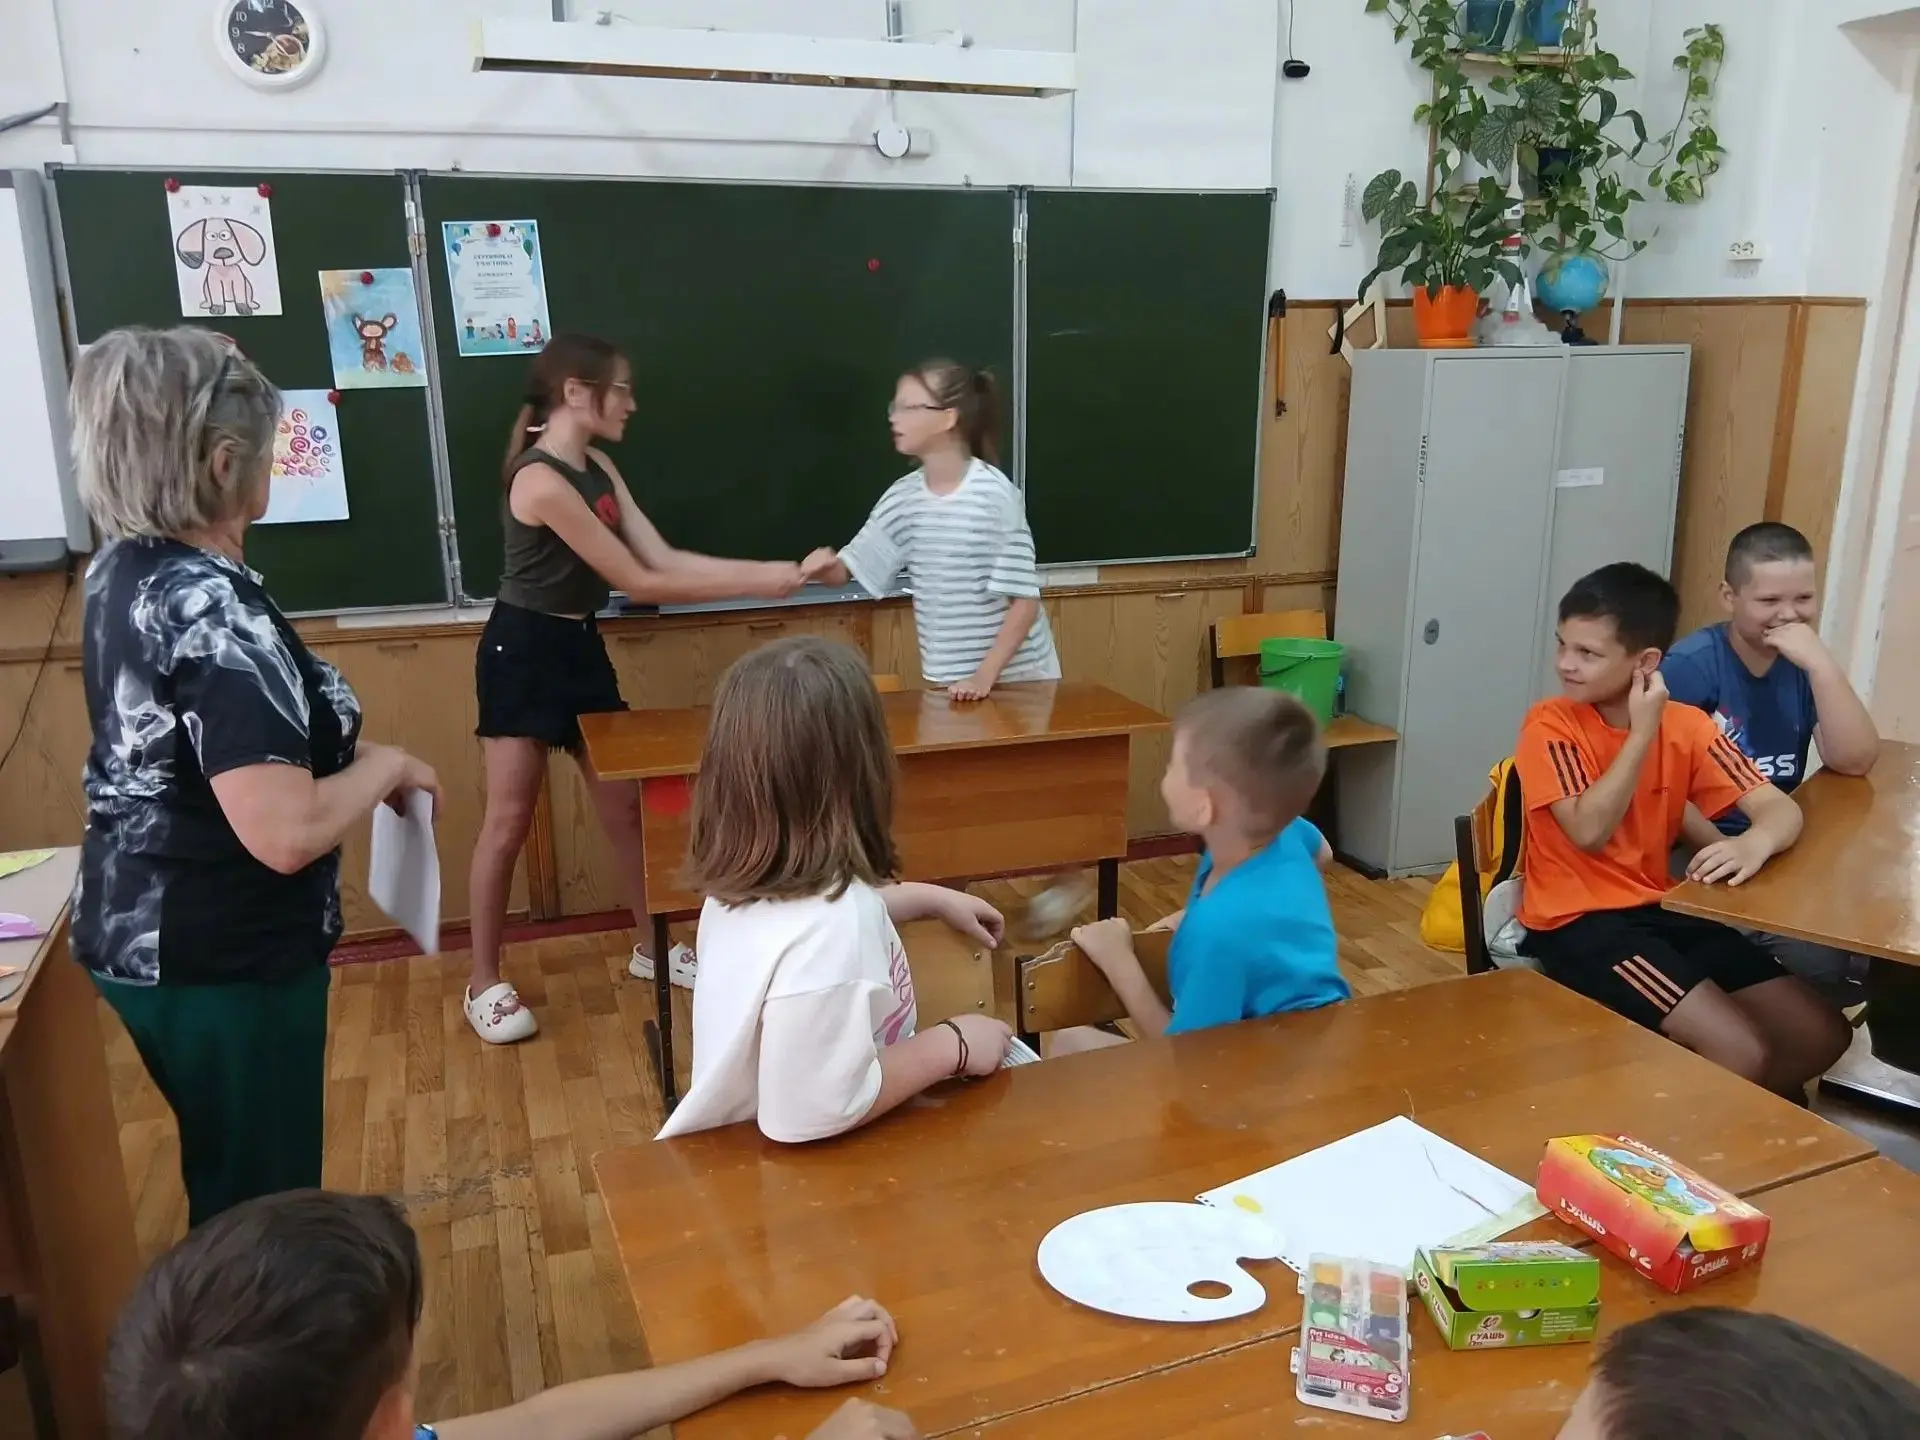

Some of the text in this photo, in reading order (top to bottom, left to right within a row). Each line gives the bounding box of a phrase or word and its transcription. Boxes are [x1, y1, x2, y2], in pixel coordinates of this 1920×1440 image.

[235, 11, 248, 22] 10
[231, 26, 240, 38] 9
[237, 43, 246, 53] 8
[1748, 754, 1796, 777] SS
[1560, 1196, 1607, 1236] ГУАШЬ
[1741, 1242, 1759, 1260] 12
[1692, 1255, 1730, 1279] ГУАШЬ
[1470, 1332, 1505, 1341] ГУАШЬ
